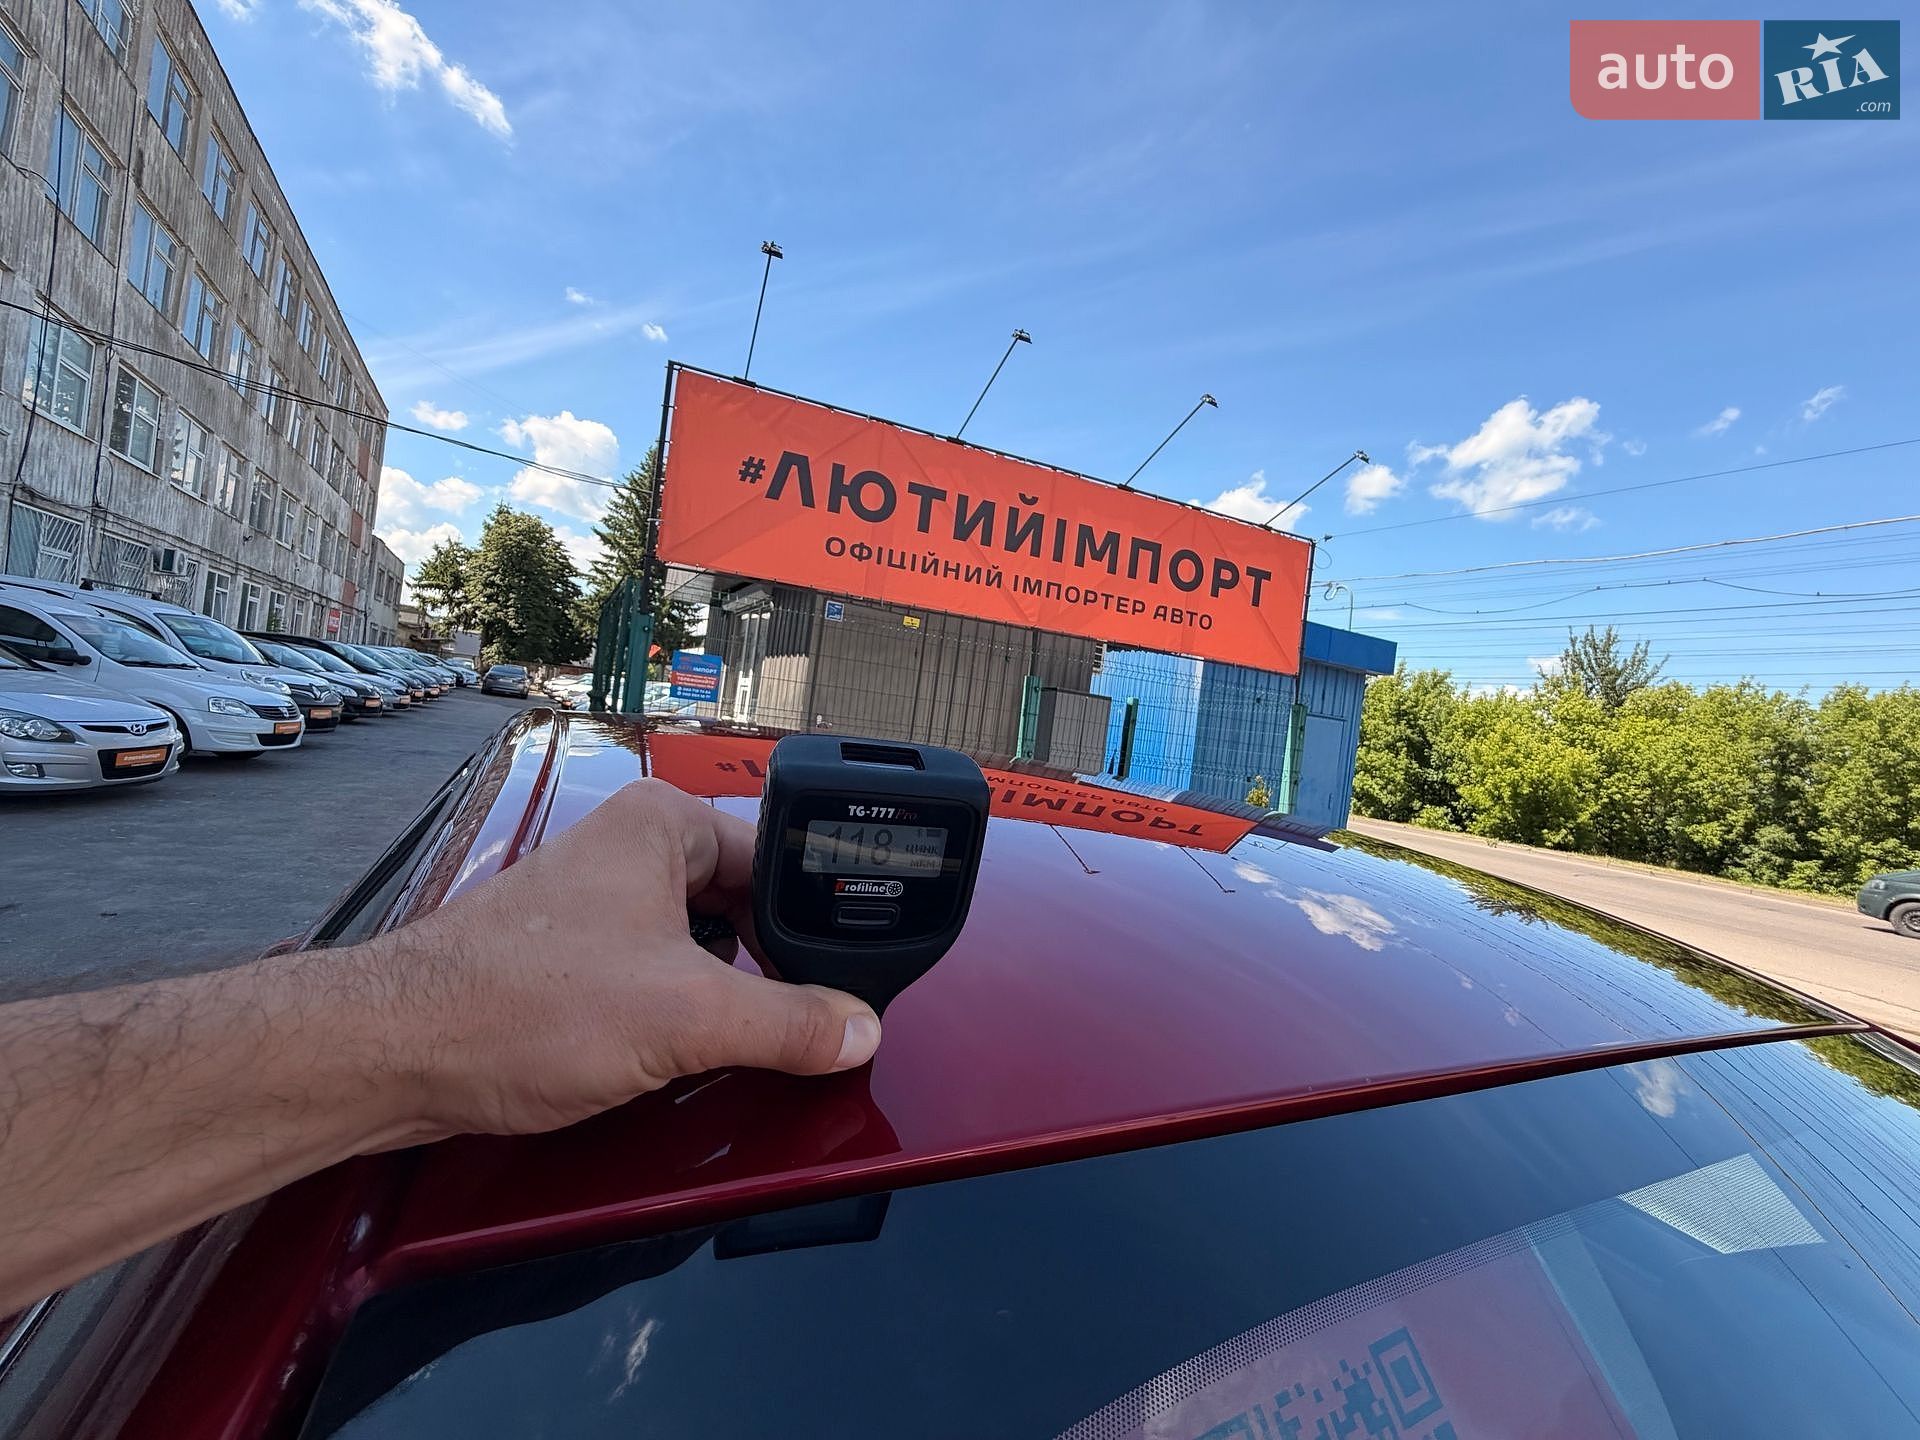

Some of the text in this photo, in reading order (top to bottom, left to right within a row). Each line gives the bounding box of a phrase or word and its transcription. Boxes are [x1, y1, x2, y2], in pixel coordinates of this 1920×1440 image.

[738, 450, 1272, 607] #ЛЮТИЙІМПОРТ
[825, 535, 1213, 630] ОФІЦІЙНИЙ ІМПОРТЕР АВТО
[827, 826, 893, 866] 118
[835, 880, 888, 894] Profiline
